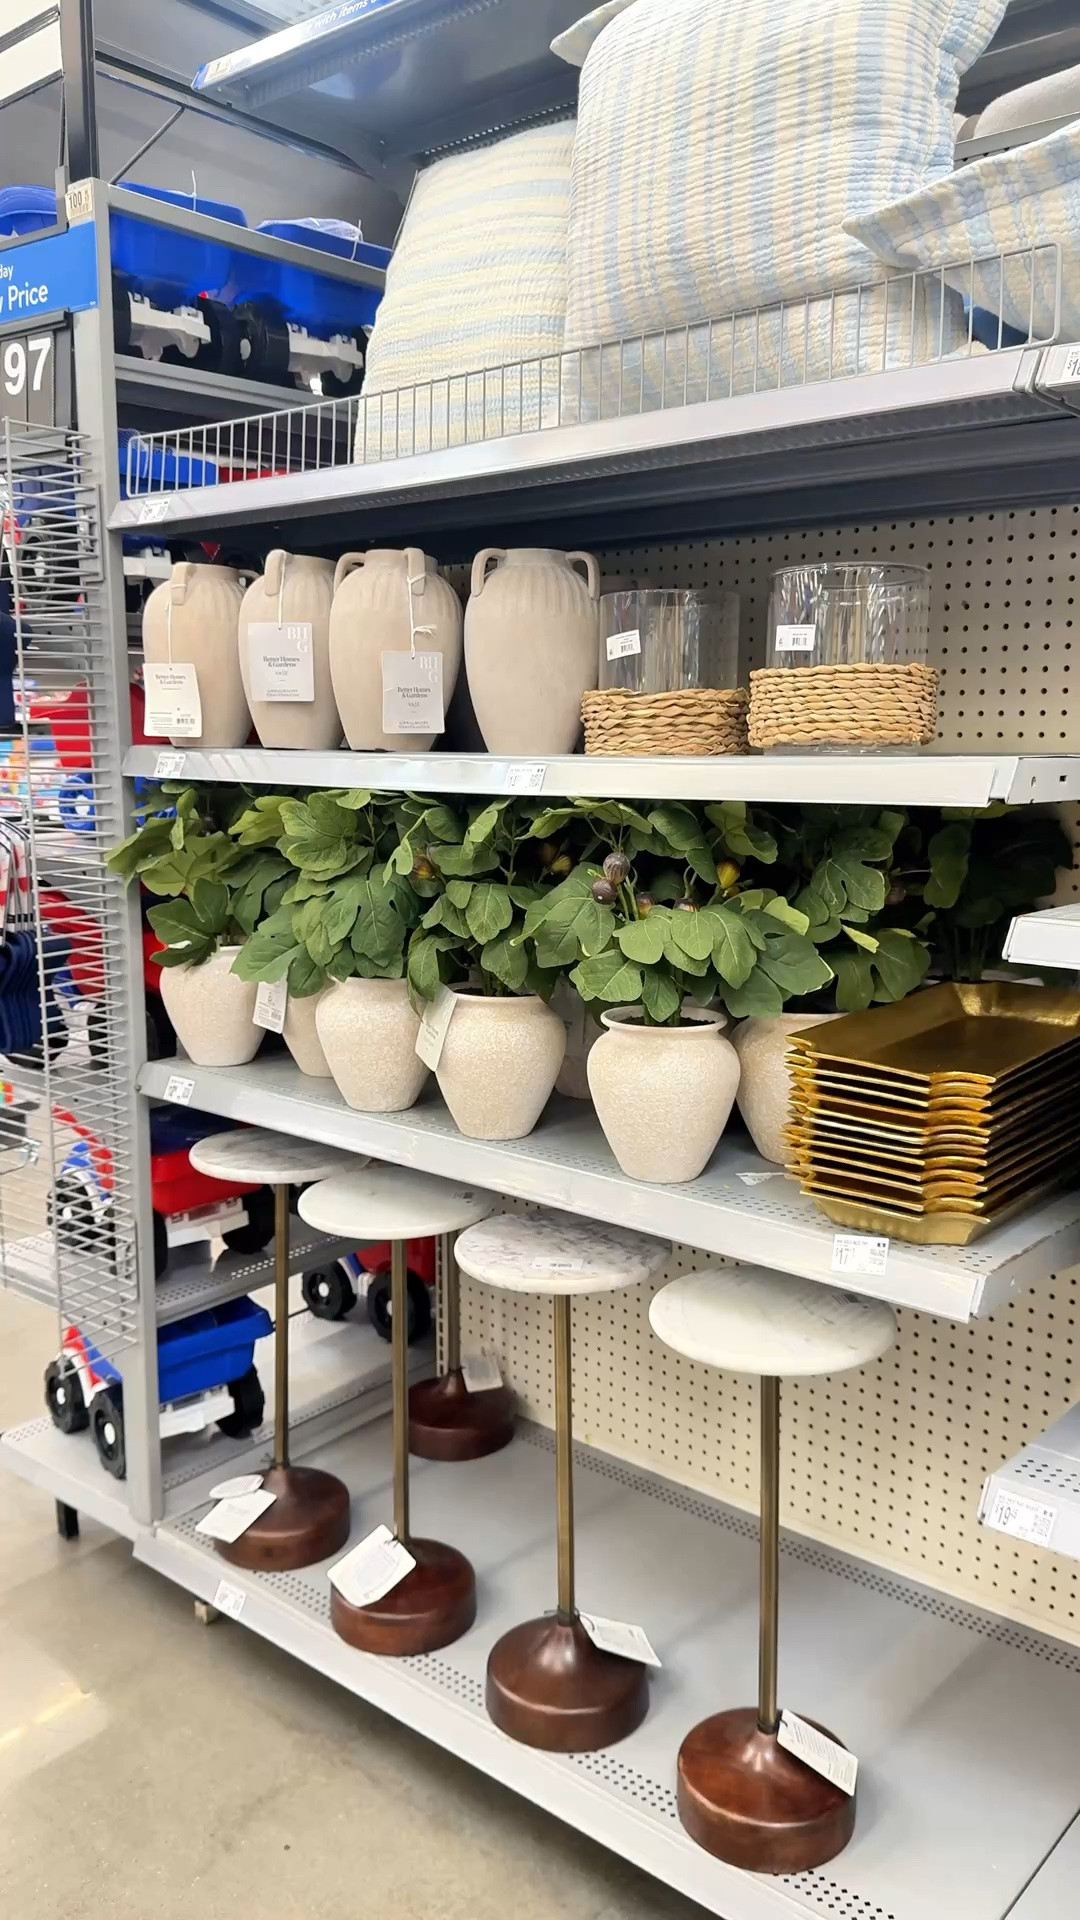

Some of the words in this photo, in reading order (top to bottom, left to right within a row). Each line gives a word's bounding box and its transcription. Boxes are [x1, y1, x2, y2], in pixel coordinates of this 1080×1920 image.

[314, 12, 337, 28] with
[339, 0, 368, 18] items
[8, 281, 49, 311] Price
[4, 337, 51, 396] 97
